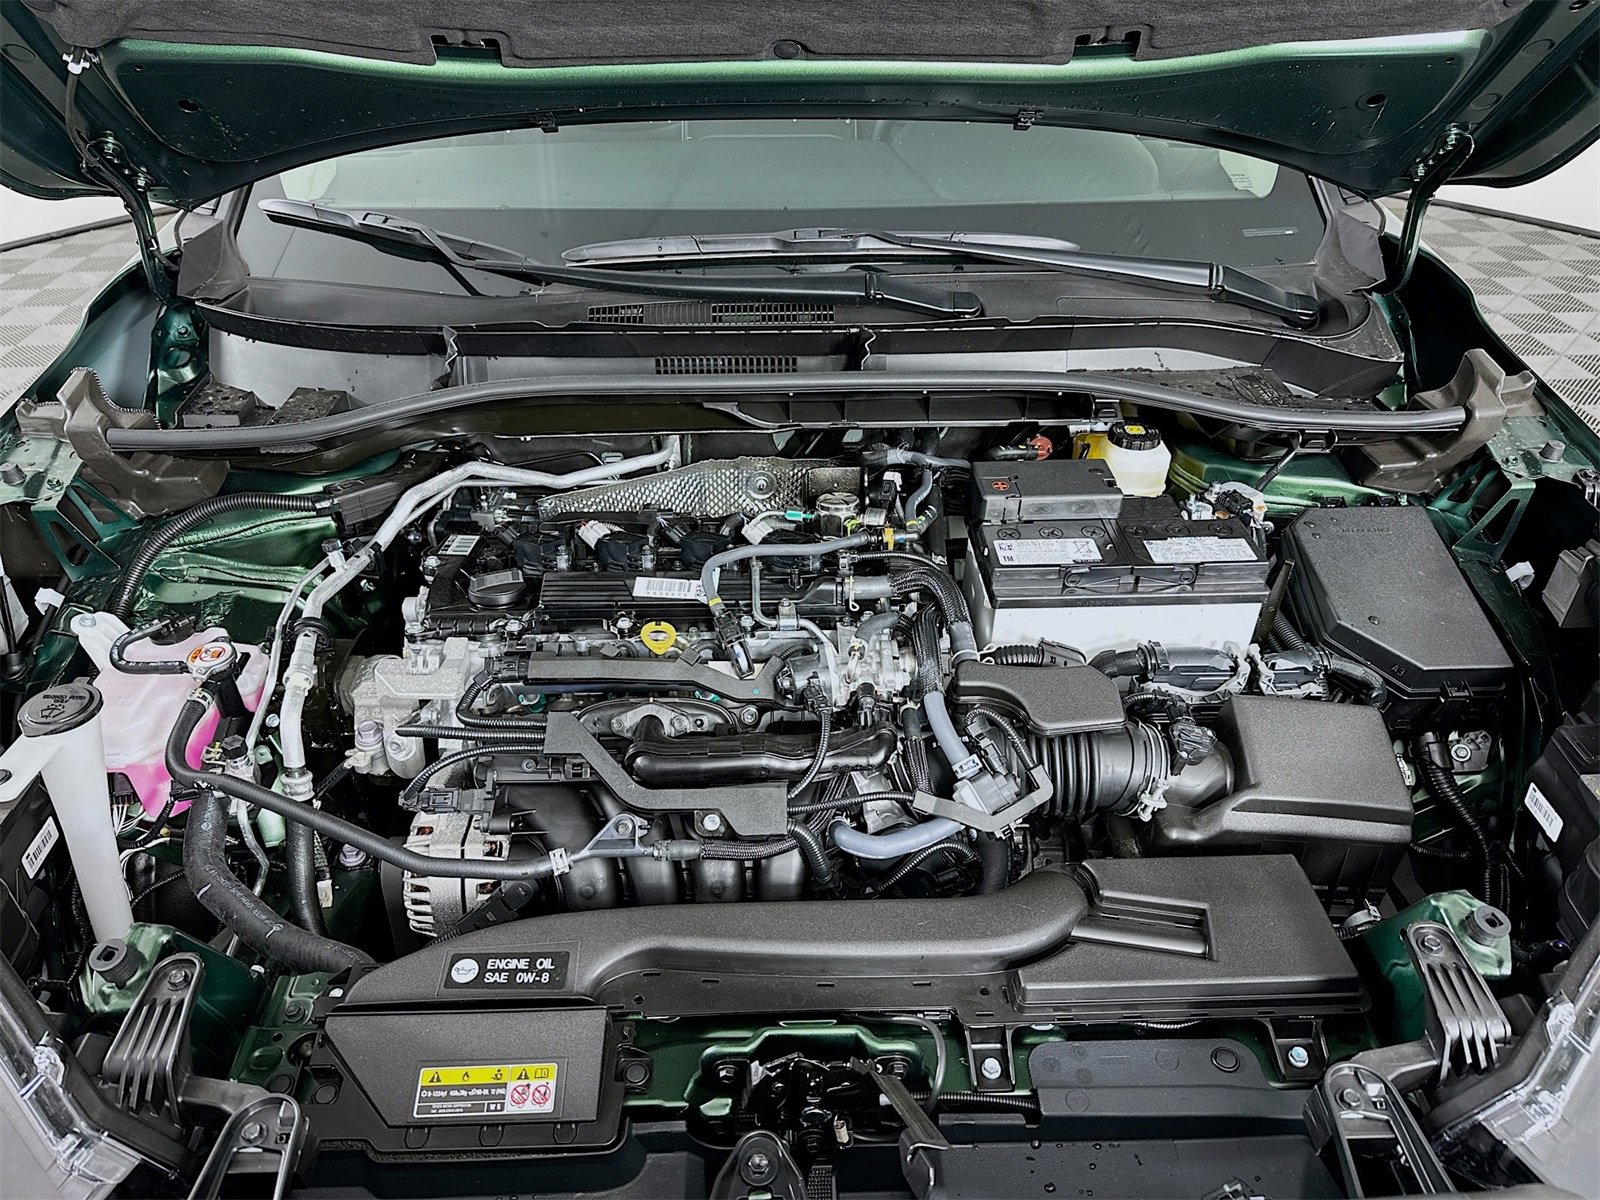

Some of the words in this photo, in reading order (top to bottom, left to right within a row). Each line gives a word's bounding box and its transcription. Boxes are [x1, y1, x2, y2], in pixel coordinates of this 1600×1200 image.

[1391, 664, 1406, 677] A3
[487, 958, 530, 970] ENGINE
[536, 958, 555, 970] OIL
[484, 972, 509, 983] SAE
[516, 972, 550, 983] 0W-8
